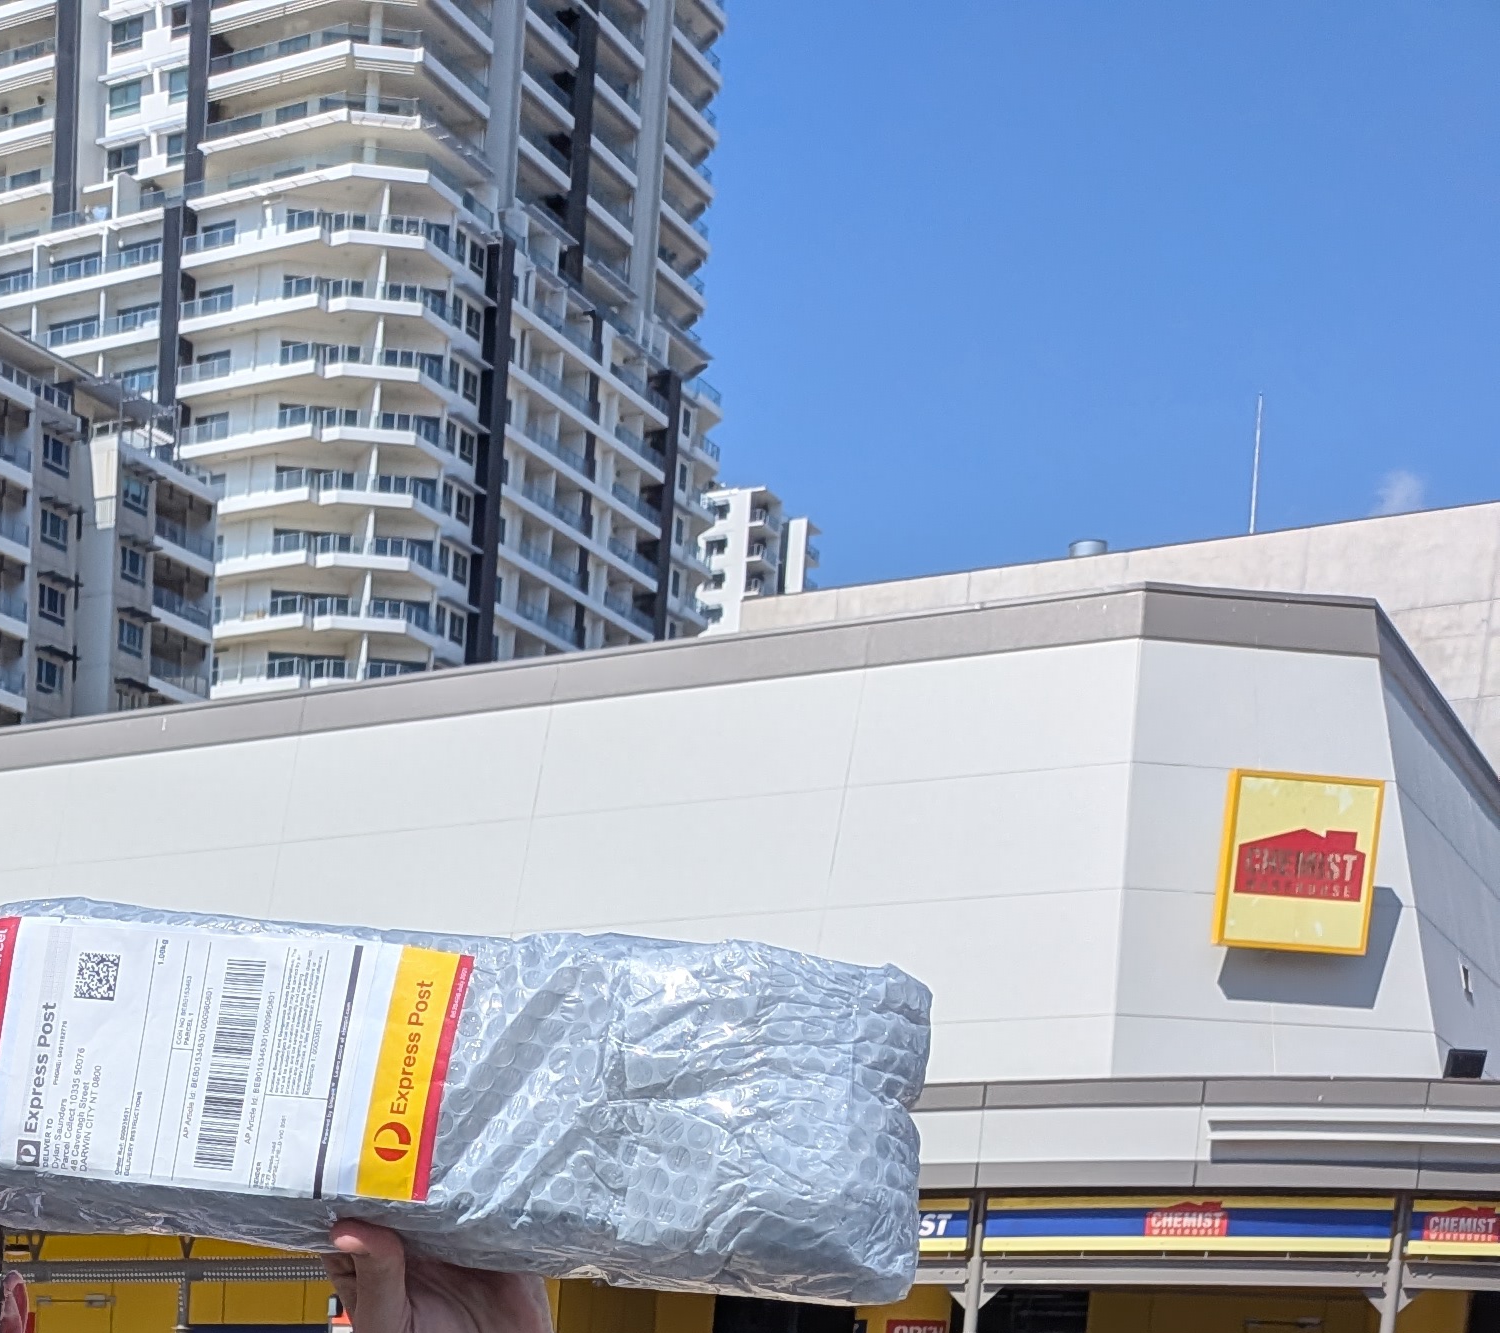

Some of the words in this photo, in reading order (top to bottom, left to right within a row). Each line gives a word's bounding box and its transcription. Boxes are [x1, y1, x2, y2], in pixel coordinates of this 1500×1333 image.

[1246, 848, 1357, 882] CHEMIST
[183, 1018, 192, 1045] PARCEL
[389, 1031, 422, 1114] Express
[407, 979, 433, 1026] Post
[24, 1053, 49, 1133] Express
[37, 1001, 56, 1047] Post
[73, 1047, 84, 1075] 50076
[91, 1065, 101, 1088] 0800
[69, 1077, 79, 1104] 10335
[78, 1081, 89, 1108] Street
[89, 1090, 98, 1103] NT
[45, 1118, 53, 1129] TO
[54, 1098, 67, 1140] Saunders
[63, 1107, 75, 1138] Collect
[85, 1106, 95, 1129] CITY
[184, 1101, 194, 1125] Article
[246, 1107, 256, 1130] Article
[70, 1111, 86, 1156] Cavenagh
[182, 1127, 190, 1138] AP
[243, 1132, 252, 1143] AP
[41, 1131, 51, 1167] DELIVER
[50, 1143, 61, 1168] Dylan
[59, 1141, 70, 1169] Parcel
[78, 1132, 91, 1171] DARWIN
[69, 1159, 77, 1170] 48
[1151, 1212, 1223, 1228] CHEMIST
[1429, 1217, 1496, 1233] CHEMIST
